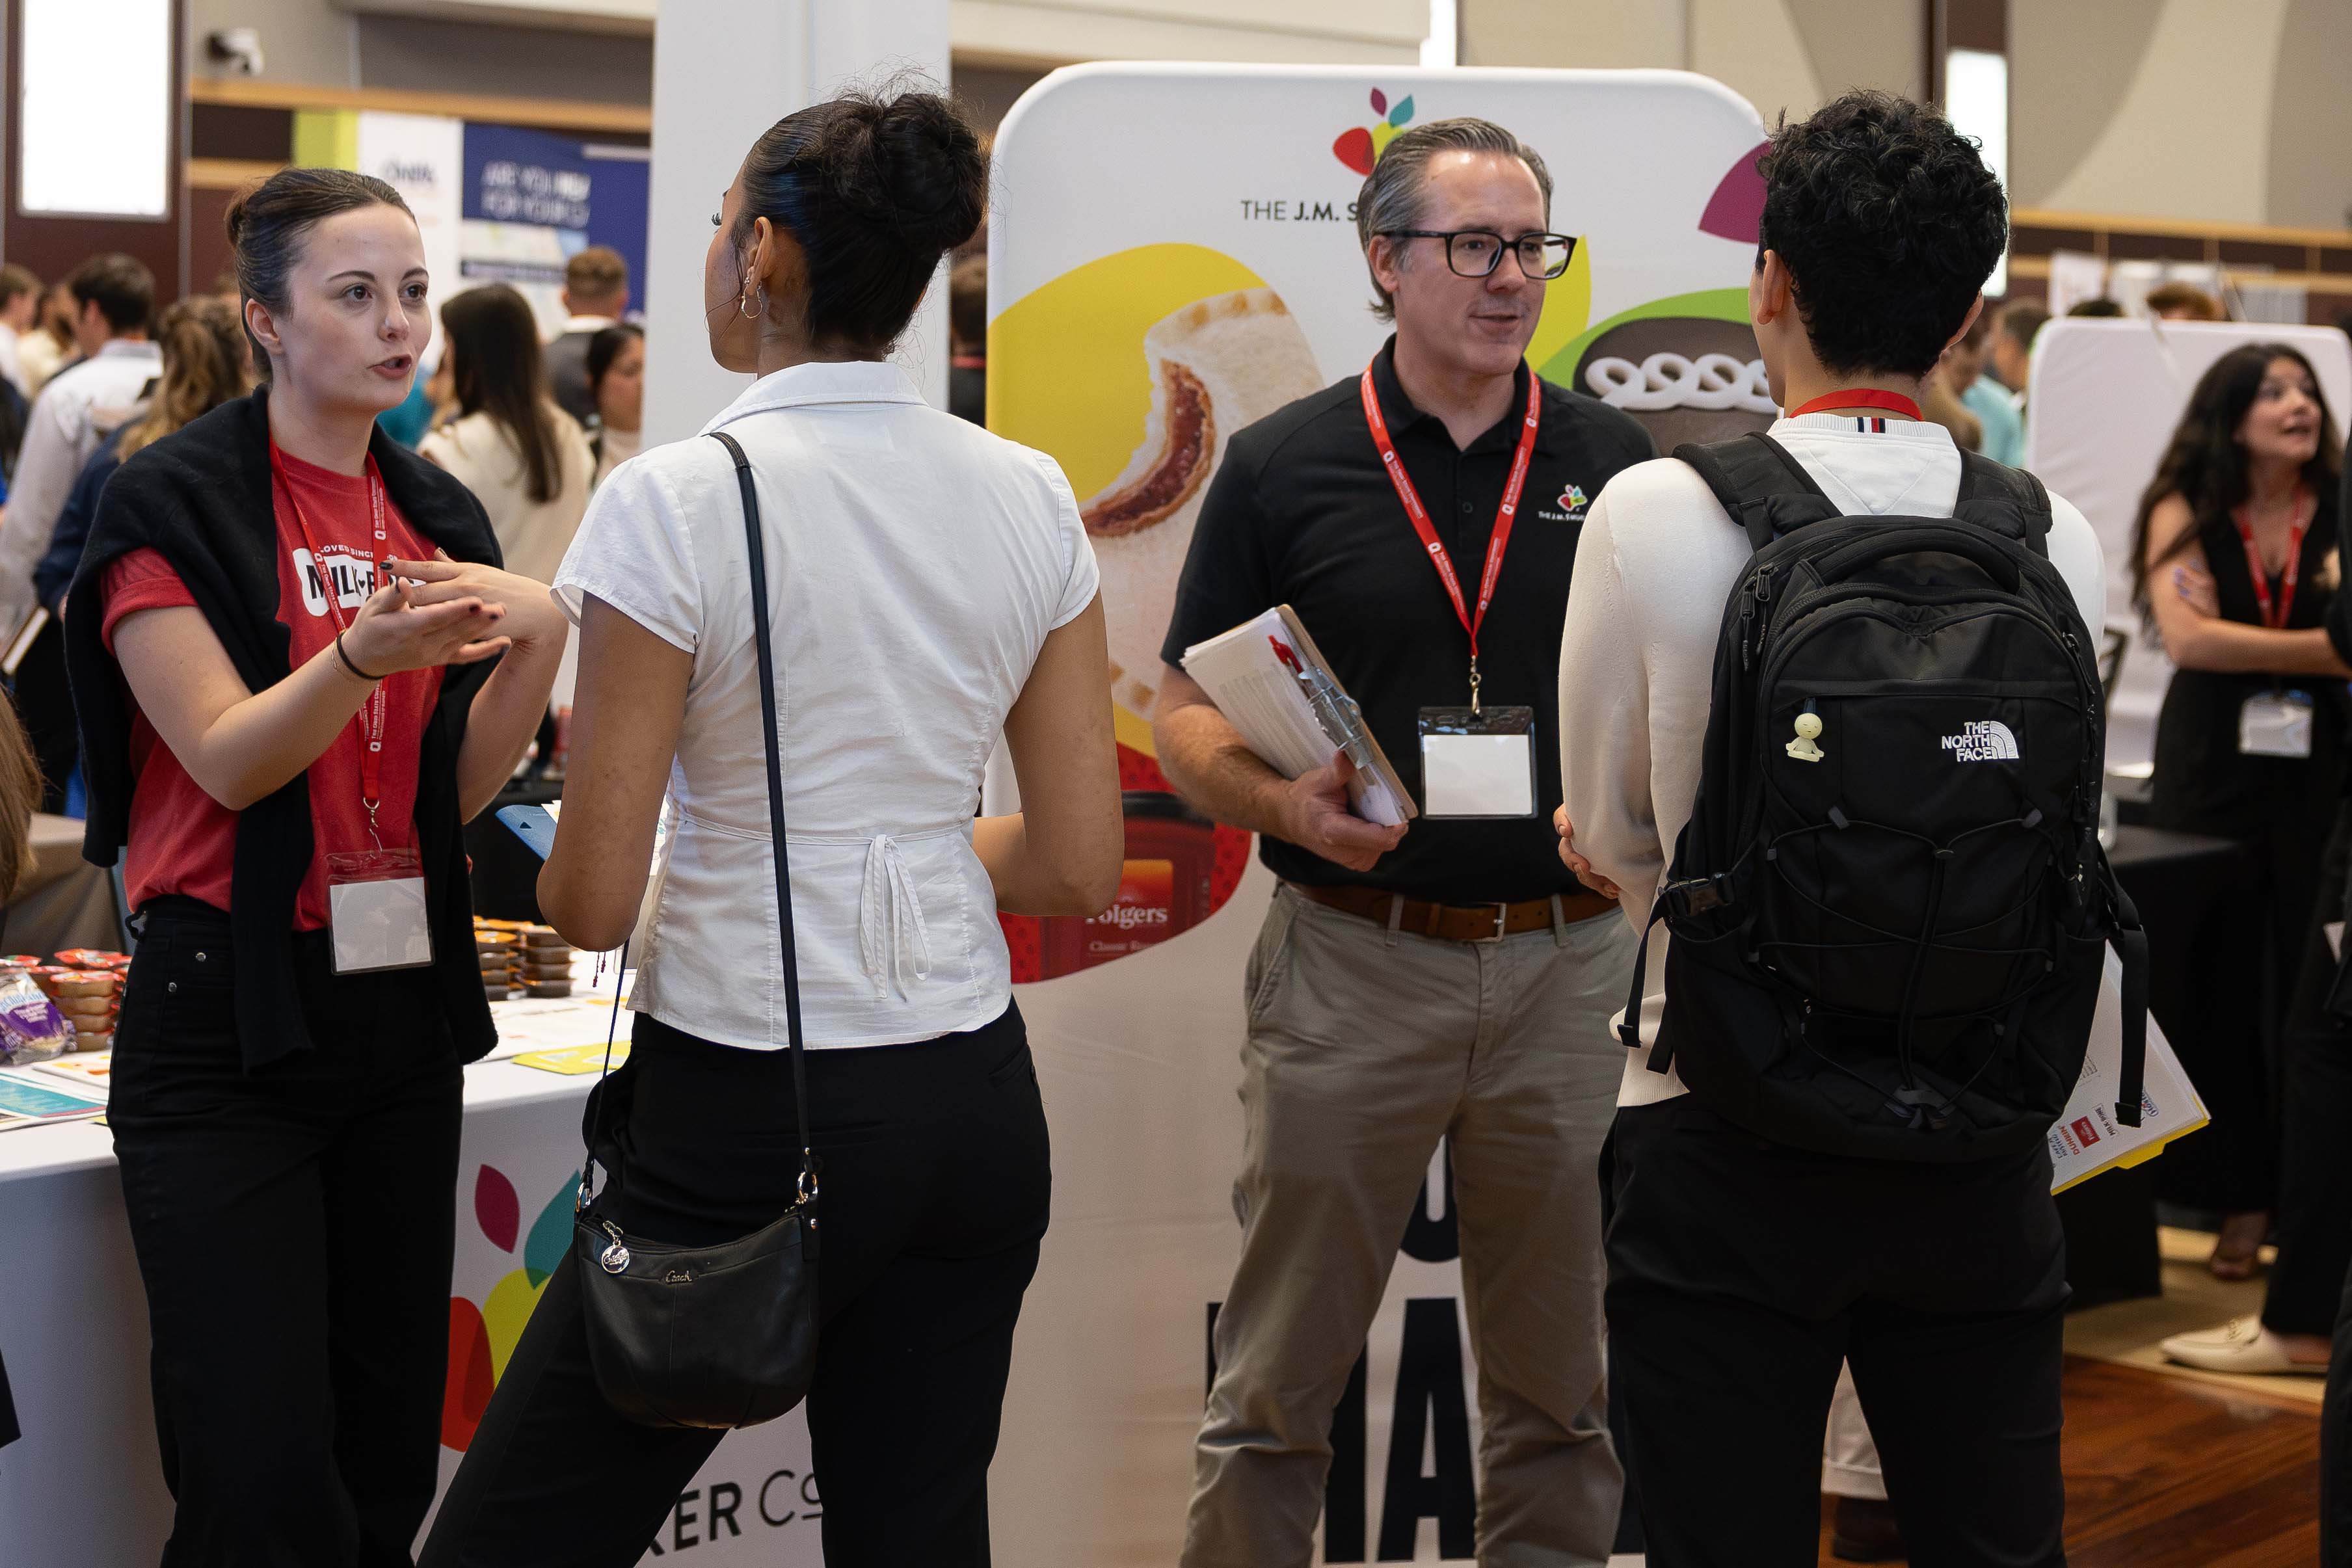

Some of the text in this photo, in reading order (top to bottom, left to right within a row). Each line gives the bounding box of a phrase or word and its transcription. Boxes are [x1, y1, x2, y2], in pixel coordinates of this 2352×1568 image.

[1241, 200, 1359, 222] THE J.M. S
[1964, 721, 1990, 735] THE
[1942, 734, 1990, 749] NORTH
[1956, 747, 1993, 762] FACE
[1085, 904, 1168, 930] olgers
[665, 1269, 693, 1283] Coach
[649, 1481, 742, 1557] ER
